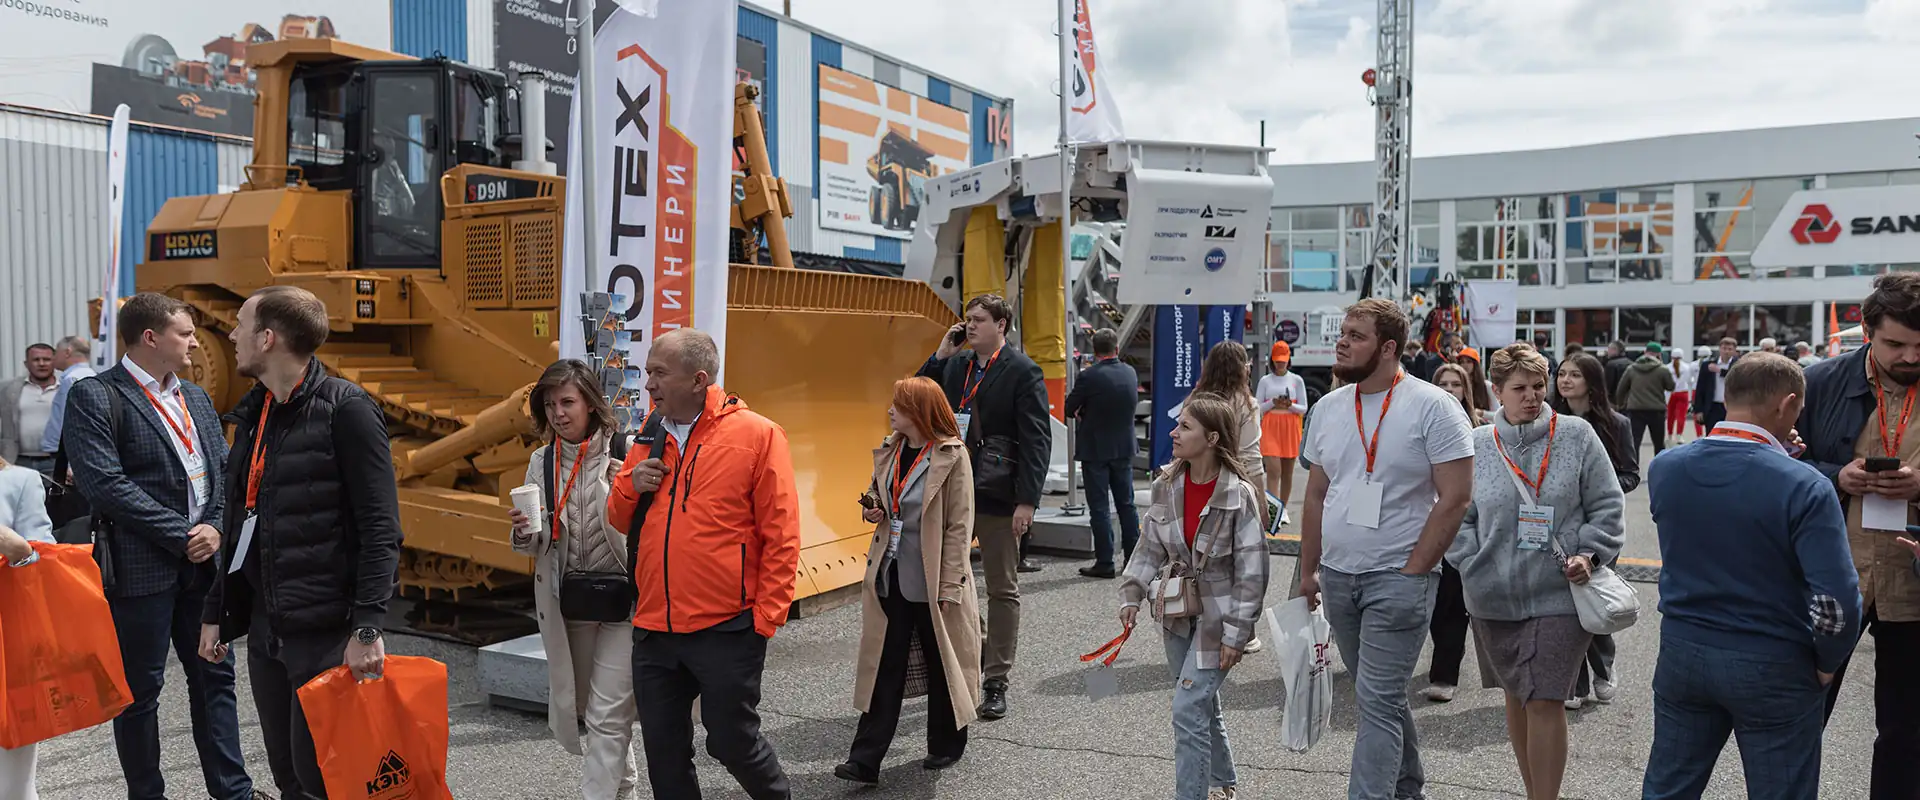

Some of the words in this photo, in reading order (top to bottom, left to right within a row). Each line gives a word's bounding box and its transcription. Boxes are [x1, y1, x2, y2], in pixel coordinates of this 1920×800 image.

[0, 0, 108, 27] борудования
[506, 2, 564, 28] COMPONENTS
[988, 106, 1012, 149] П4
[468, 180, 507, 201] SD9N
[608, 77, 651, 341] OTEX
[1851, 215, 1920, 235] SAN
[165, 233, 213, 257] HBXG
[1174, 305, 1184, 387] Минпромторг
[1183, 343, 1192, 387] России
